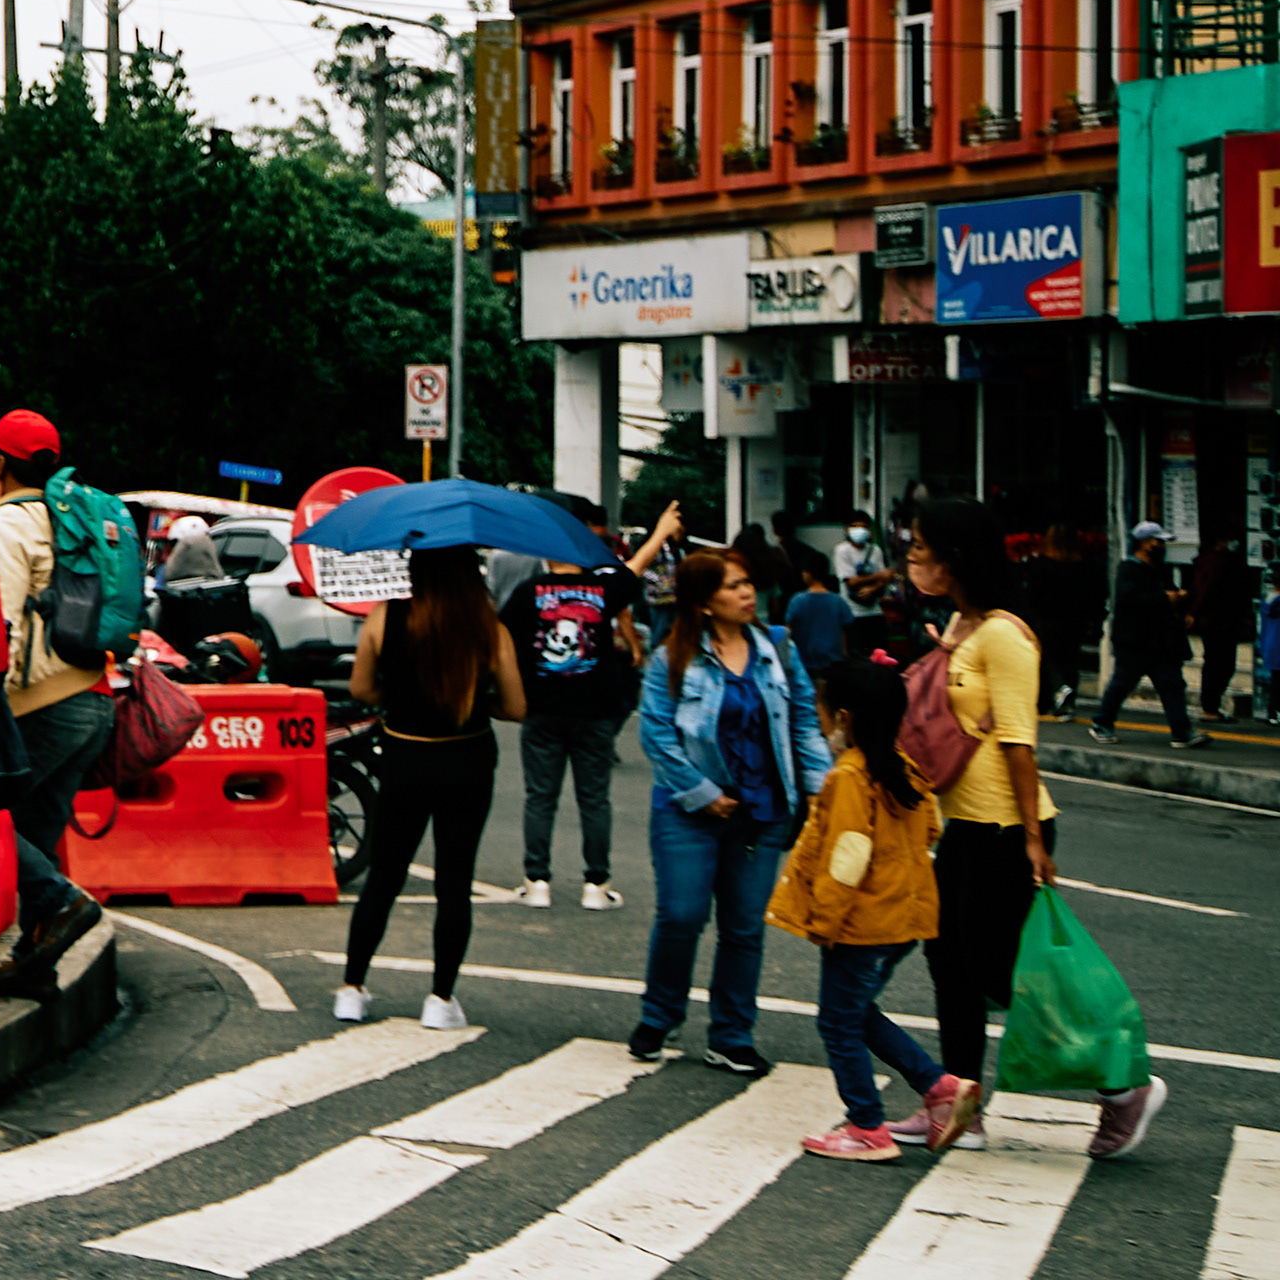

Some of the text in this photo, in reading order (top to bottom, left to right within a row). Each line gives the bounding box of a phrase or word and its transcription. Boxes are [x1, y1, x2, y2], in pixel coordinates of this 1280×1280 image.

[942, 224, 1079, 276] VILLARICA
[593, 263, 693, 305] Generika
[637, 305, 693, 326] drugstore
[211, 716, 263, 735] CEO
[277, 716, 315, 749] 103
